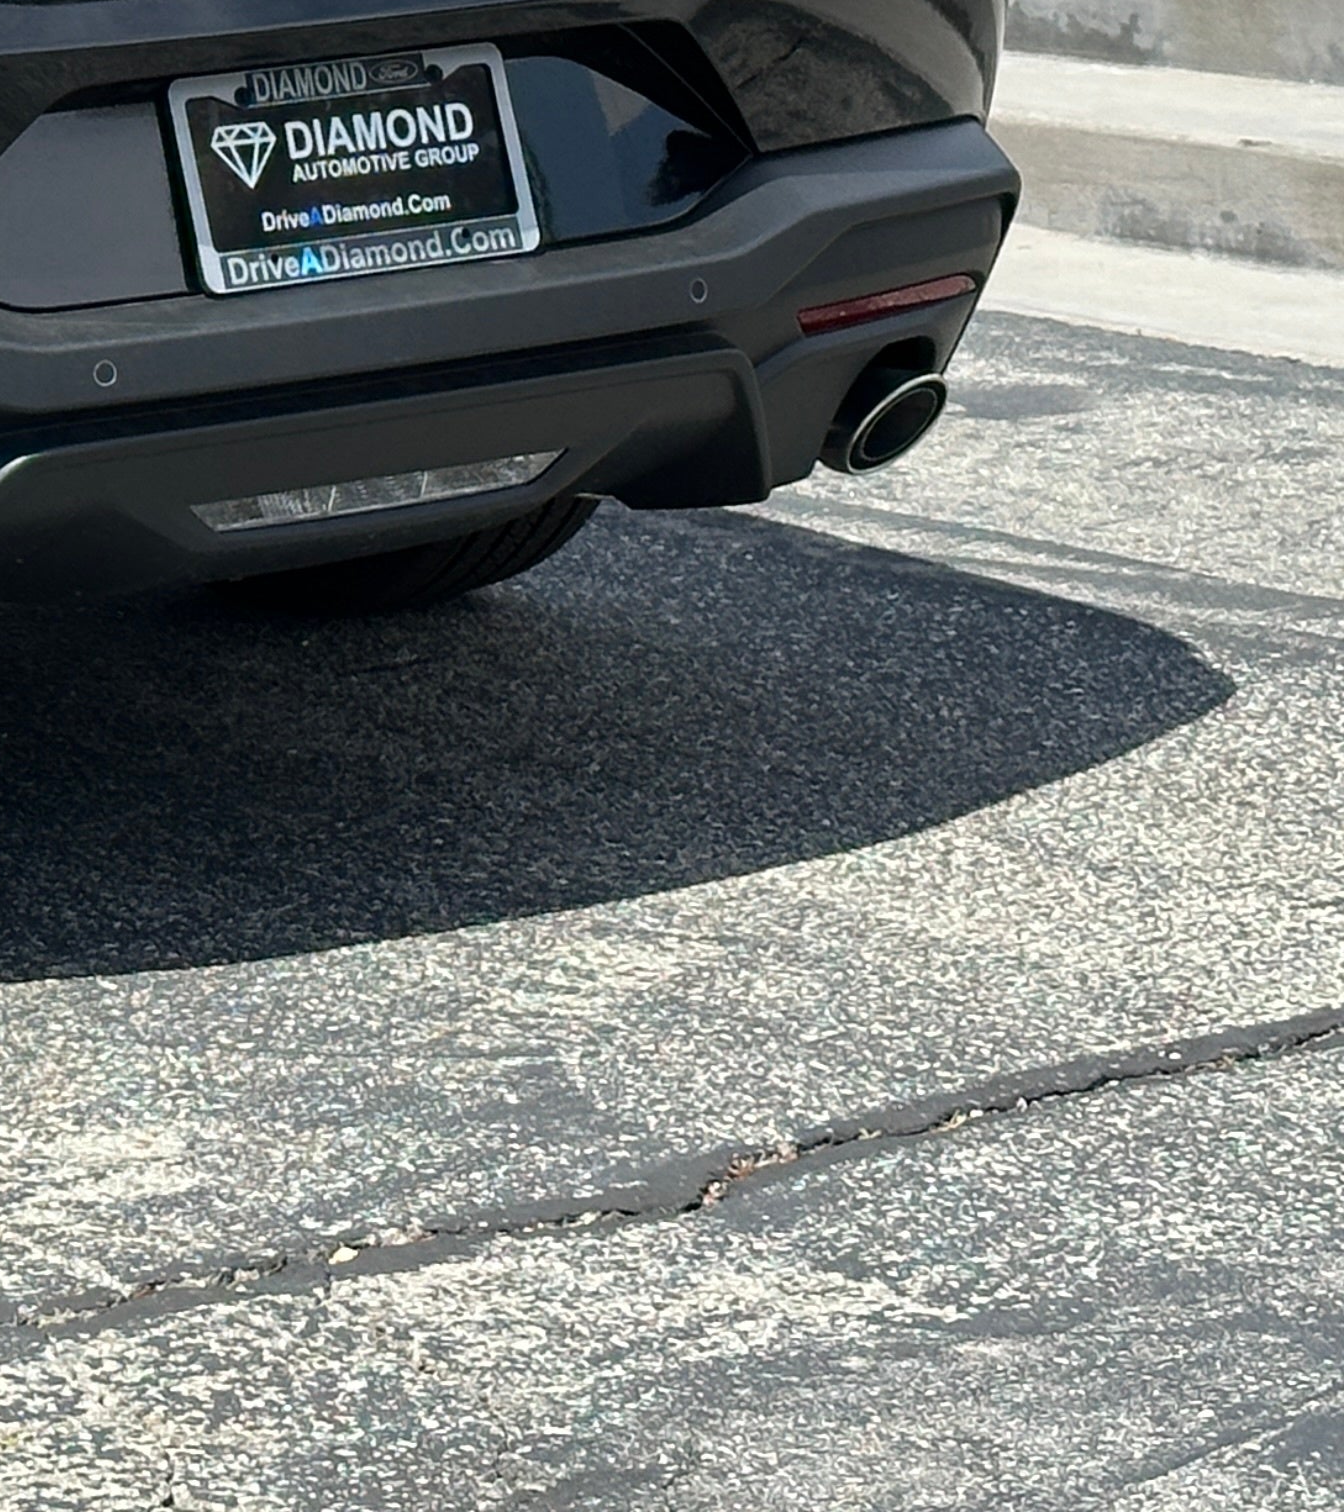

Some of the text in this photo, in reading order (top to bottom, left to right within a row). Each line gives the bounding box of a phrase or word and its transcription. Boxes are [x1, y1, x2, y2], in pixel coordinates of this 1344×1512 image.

[252, 61, 367, 103] DIAMOND
[285, 102, 473, 159] DIAMOND
[292, 143, 480, 183] AUTOMOTIVE GROUP
[262, 194, 451, 232] DriveADiamond.Com
[228, 226, 516, 285] DriveADiamond.Com
